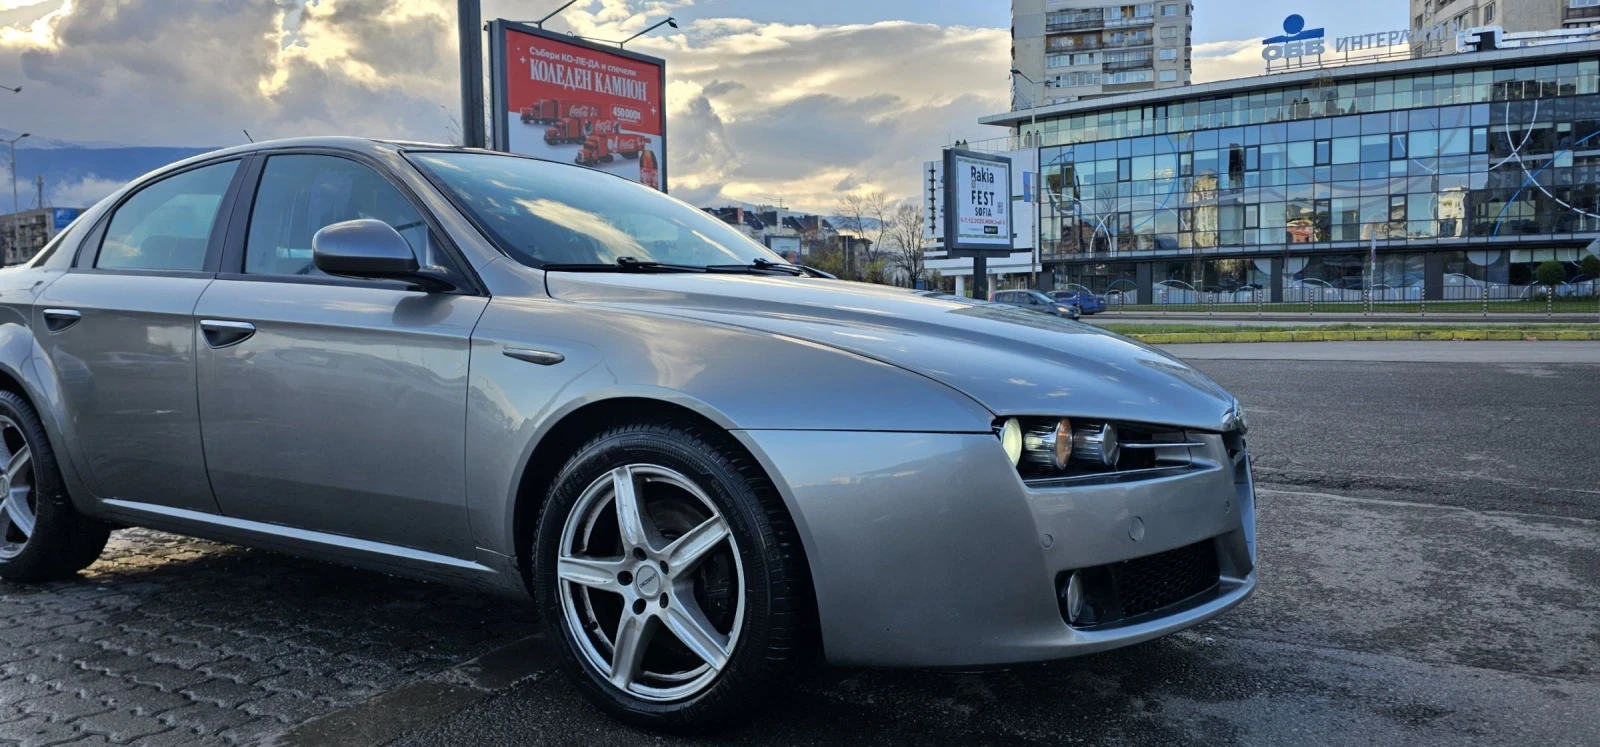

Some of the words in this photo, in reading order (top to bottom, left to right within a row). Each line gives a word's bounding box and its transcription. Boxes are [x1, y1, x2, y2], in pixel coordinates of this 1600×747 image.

[1262, 39, 1325, 61] ОББ
[529, 46, 560, 60] Събери
[561, 53, 600, 69] КО-ЛЕ-ДА
[607, 65, 637, 77] спечели
[530, 58, 592, 91] КОЛЕДЕН
[594, 71, 648, 101] КАМИОН
[971, 165, 994, 183] Rakia
[971, 190, 995, 206] FEST
[974, 207, 992, 217] SOFIA
